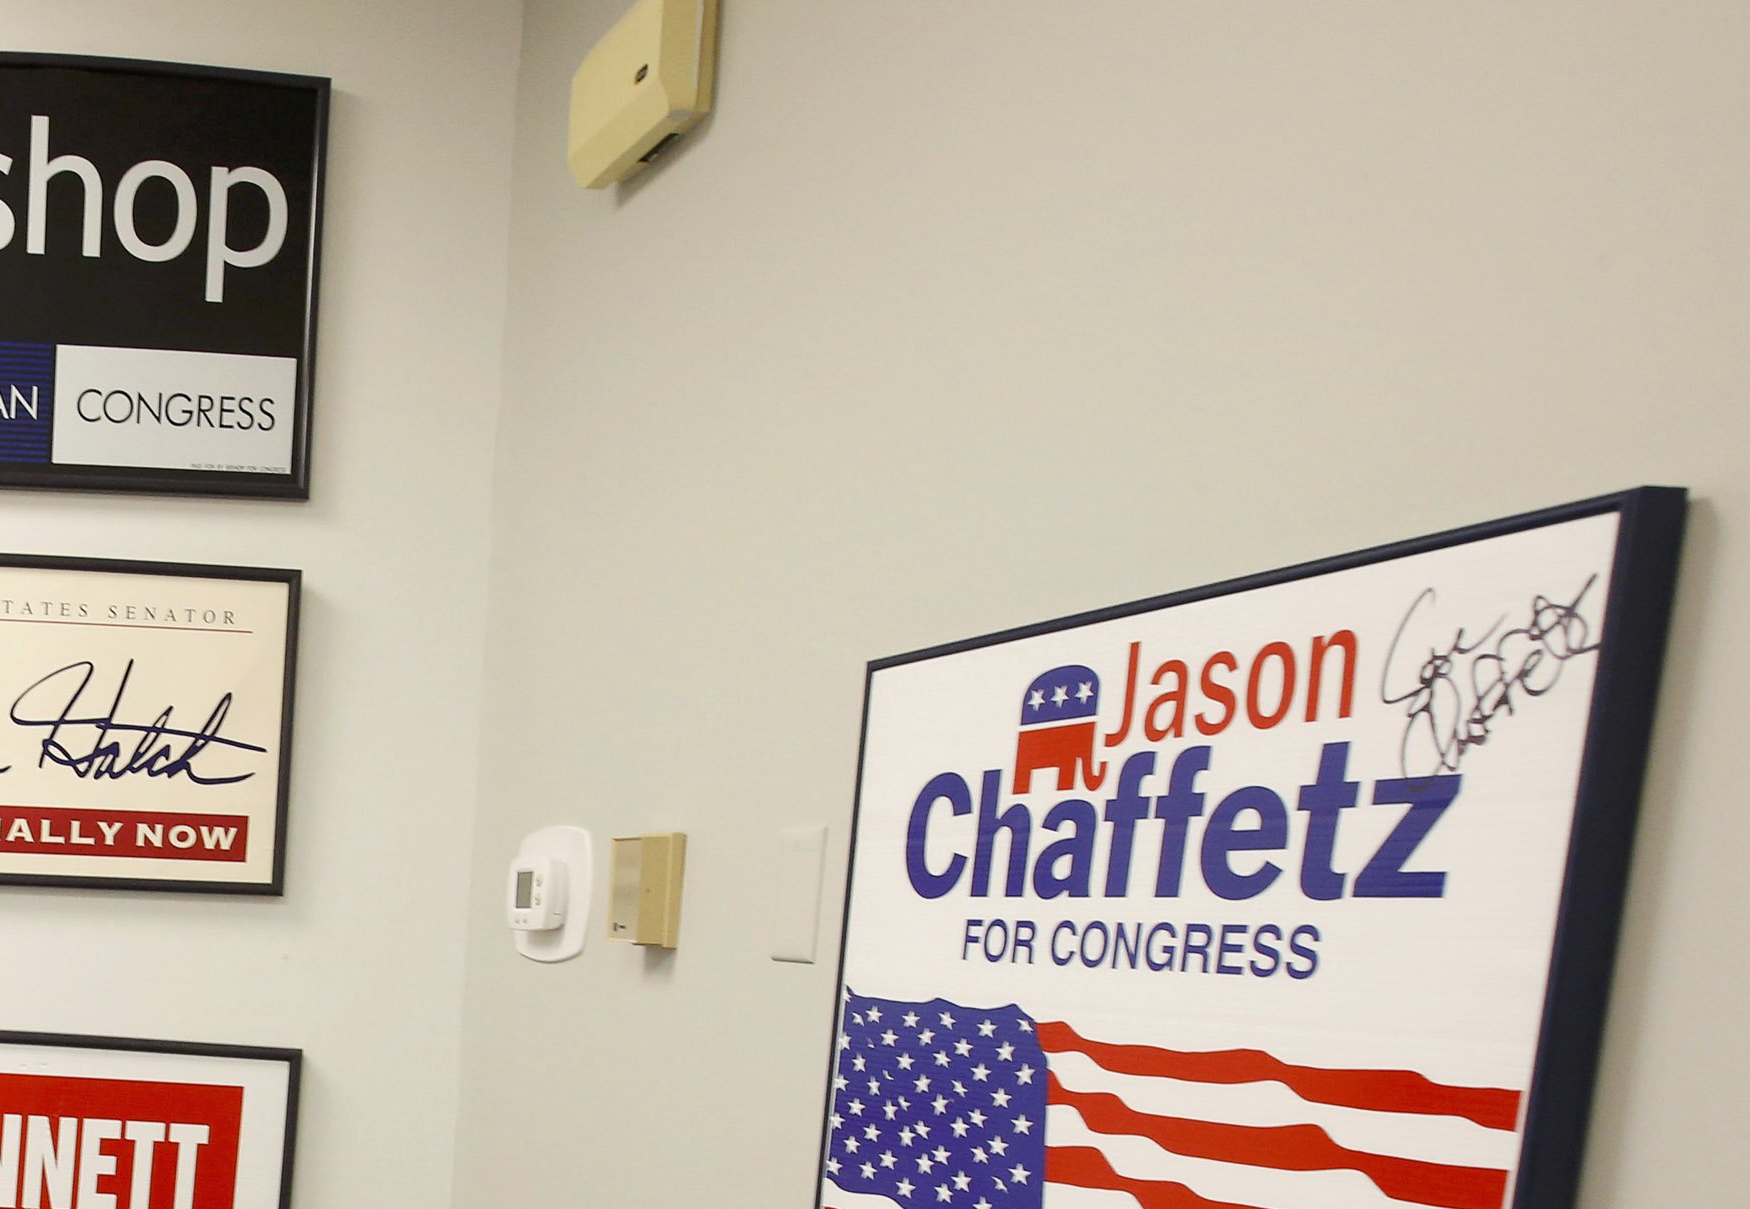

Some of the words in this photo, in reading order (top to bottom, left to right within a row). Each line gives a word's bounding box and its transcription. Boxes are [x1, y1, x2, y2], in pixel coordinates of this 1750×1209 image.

[76, 388, 276, 432] CONGRESS
[108, 604, 238, 626] SENATOR
[1104, 629, 1358, 749] Jason
[135, 823, 239, 852] NOW
[905, 741, 1464, 902] Chaffetz
[962, 918, 1036, 966] FOR
[1050, 921, 1322, 981] CONGRESS
